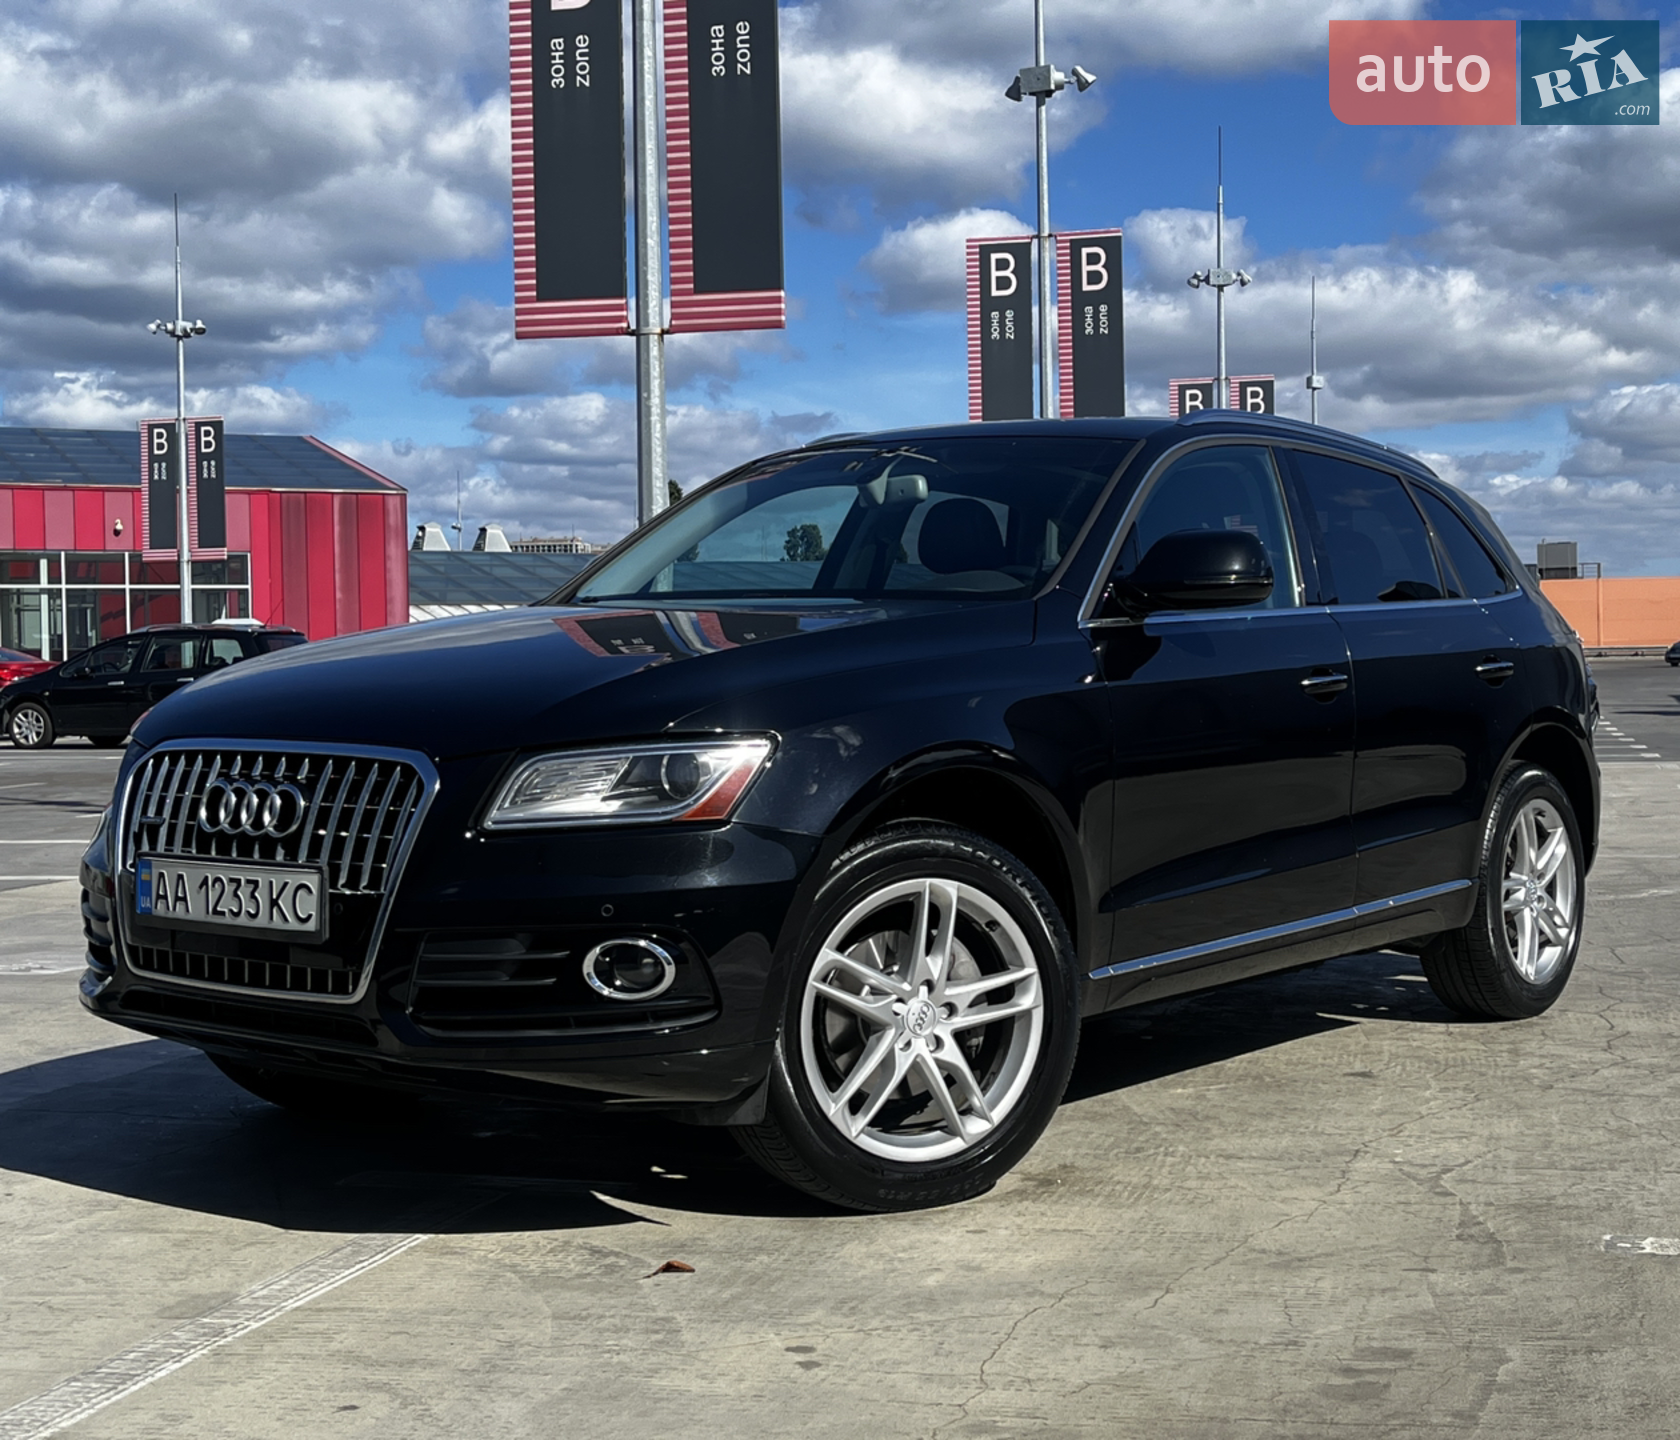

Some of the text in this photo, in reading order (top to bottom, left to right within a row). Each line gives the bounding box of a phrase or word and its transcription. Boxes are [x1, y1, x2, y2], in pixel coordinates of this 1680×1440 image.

[550, 37, 565, 89] зона
[575, 34, 590, 87] zone
[710, 24, 726, 77] зона
[735, 20, 751, 75] zone
[989, 252, 1018, 297] B
[1080, 246, 1109, 292] B
[990, 311, 1000, 340] зона
[1005, 309, 1015, 340] zone
[1084, 305, 1094, 336] зона
[1098, 304, 1109, 335] zone
[153, 428, 168, 455] B
[200, 425, 216, 453] B
[140, 895, 151, 908] UA
[154, 870, 315, 924] AA 1233 KC
